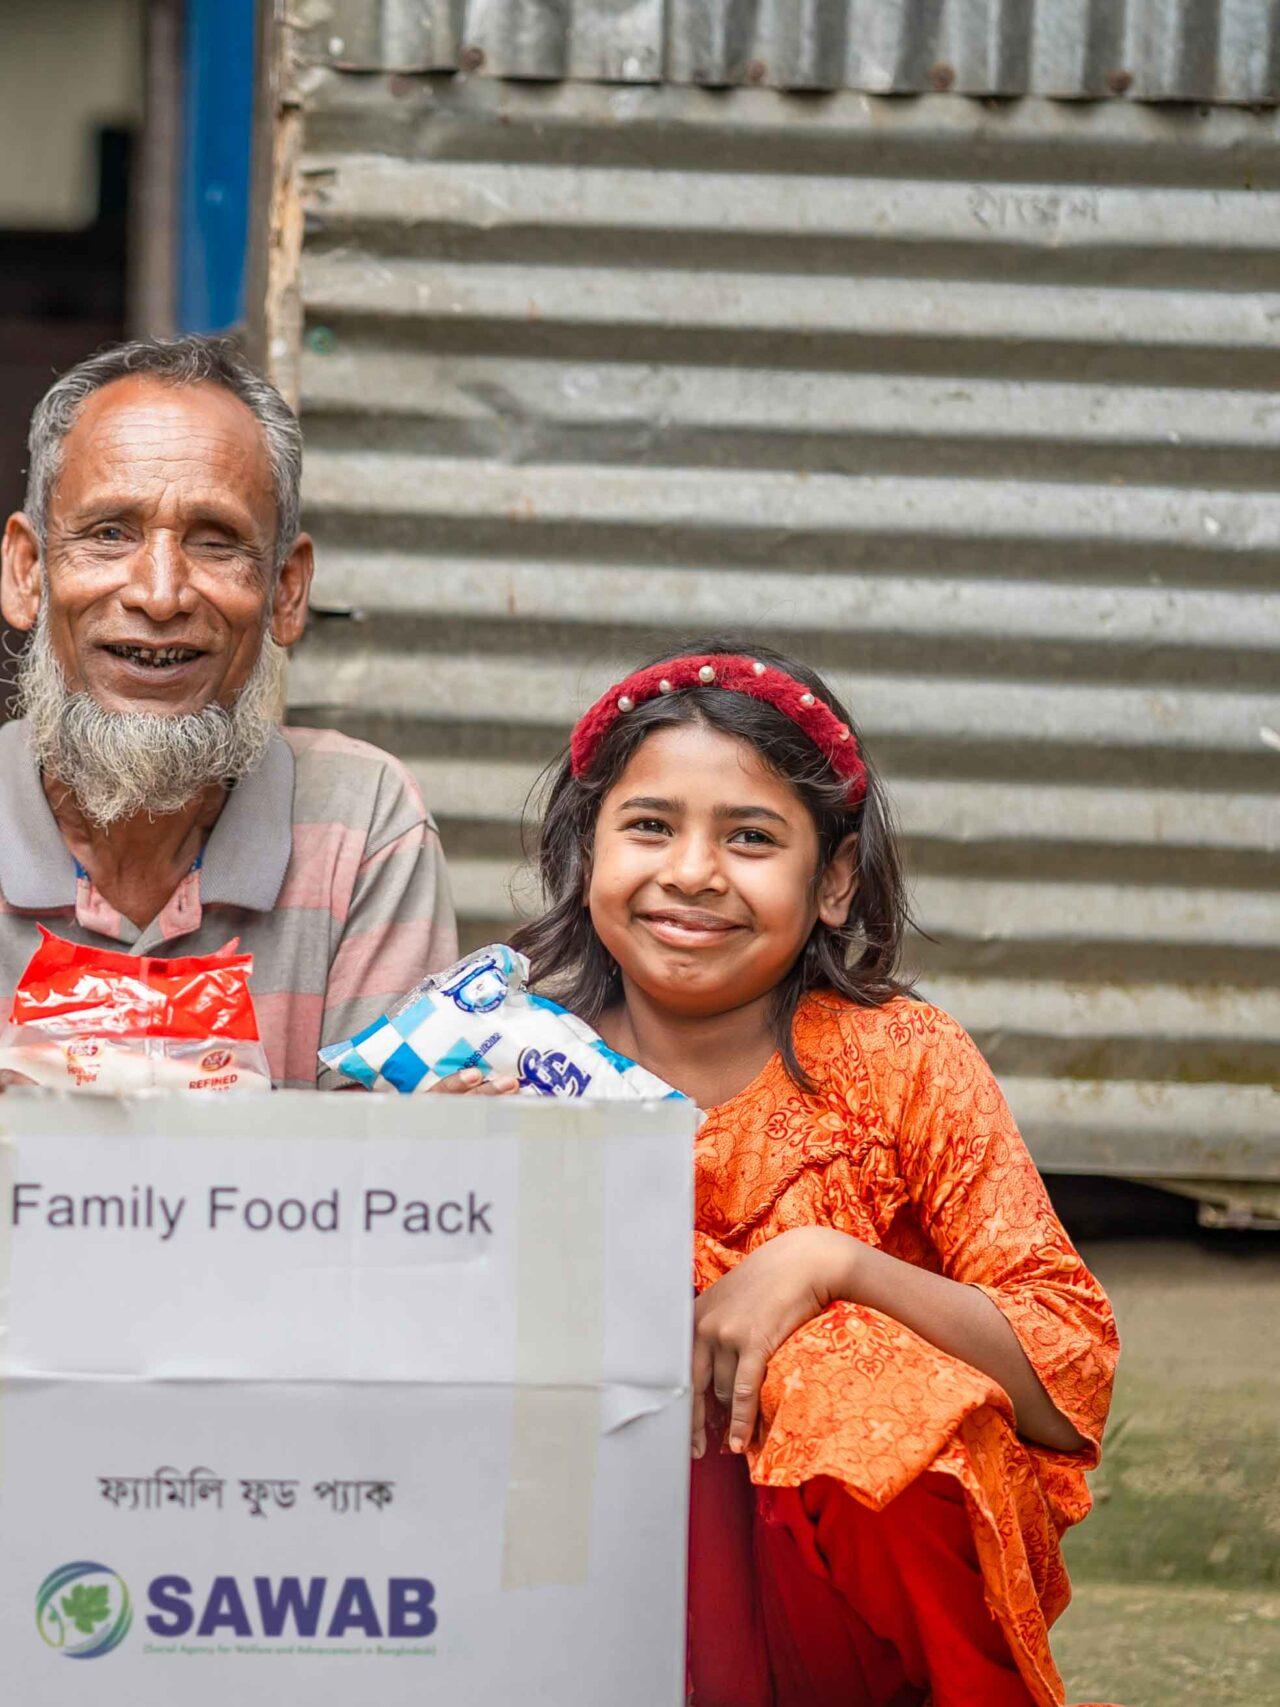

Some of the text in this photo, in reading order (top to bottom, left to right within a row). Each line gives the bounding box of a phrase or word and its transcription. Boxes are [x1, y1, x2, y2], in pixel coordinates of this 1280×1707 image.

[189, 1074, 238, 1089] REFINED
[12, 1184, 494, 1241] Family Food Pack
[97, 1466, 397, 1518] ফ্যামিলি ফুড প্যাক
[146, 1574, 438, 1638] SAWAB
